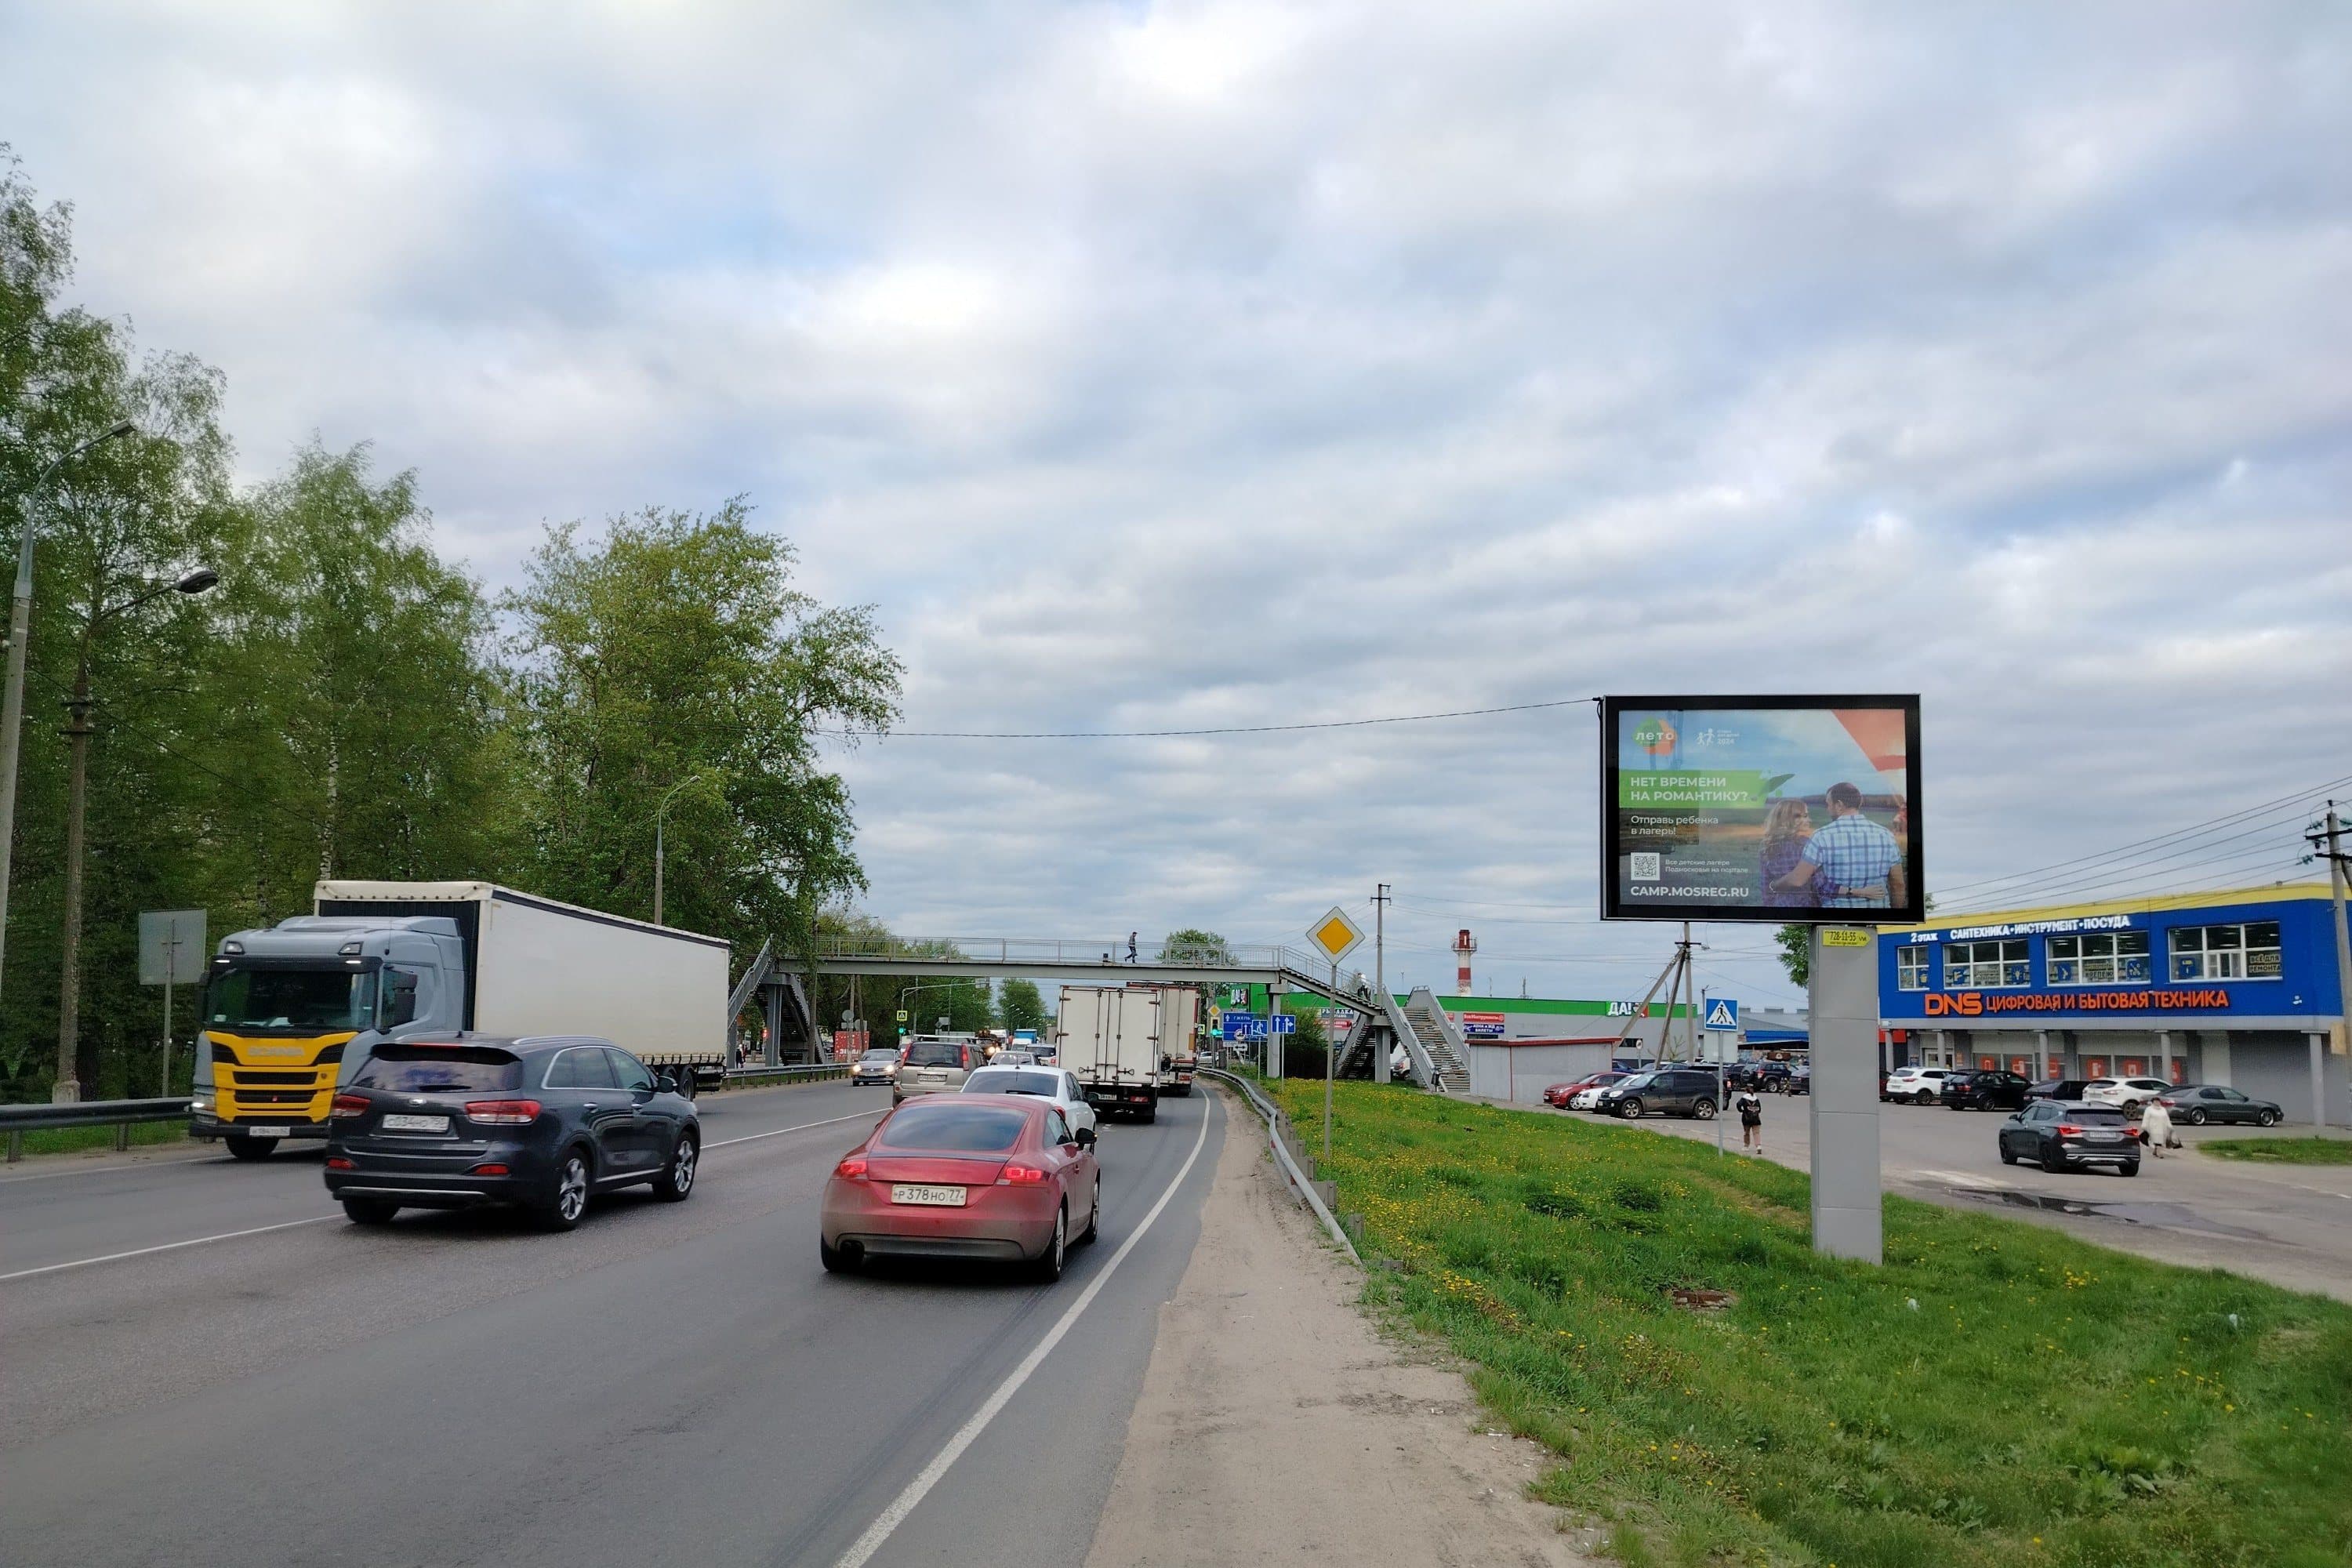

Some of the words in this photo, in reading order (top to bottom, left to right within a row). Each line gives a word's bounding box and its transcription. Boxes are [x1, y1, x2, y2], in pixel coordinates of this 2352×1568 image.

[1635, 731, 1675, 741] лето
[1631, 777, 1657, 787] НЕТ
[1660, 777, 1726, 787] ВРЕМЕНИ
[1631, 791, 1650, 801] НА
[1653, 791, 1748, 801] РОМАНТИКУ?
[1631, 815, 1674, 826] Отправь
[1675, 815, 1719, 826] ребенка
[1639, 827, 1676, 837] лагерь!
[1630, 886, 1749, 897] CAMP.MOSREG.RU
[1950, 925, 2010, 940] САНТЕХНИКА
[2014, 919, 2079, 934] ИНСТРУМЕНТ
[2084, 915, 2131, 928] ПОСУДА
[1911, 932, 1918, 942] 2
[1925, 993, 1982, 1015] DNS
[1986, 995, 2061, 1013] ЦИФРОВАЯ
[2063, 994, 2075, 1009] И
[2078, 992, 2149, 1009] БЫТОВАЯ
[2153, 990, 2230, 1008] ТЕХНИКА
[1608, 1002, 1632, 1016] ДА!
